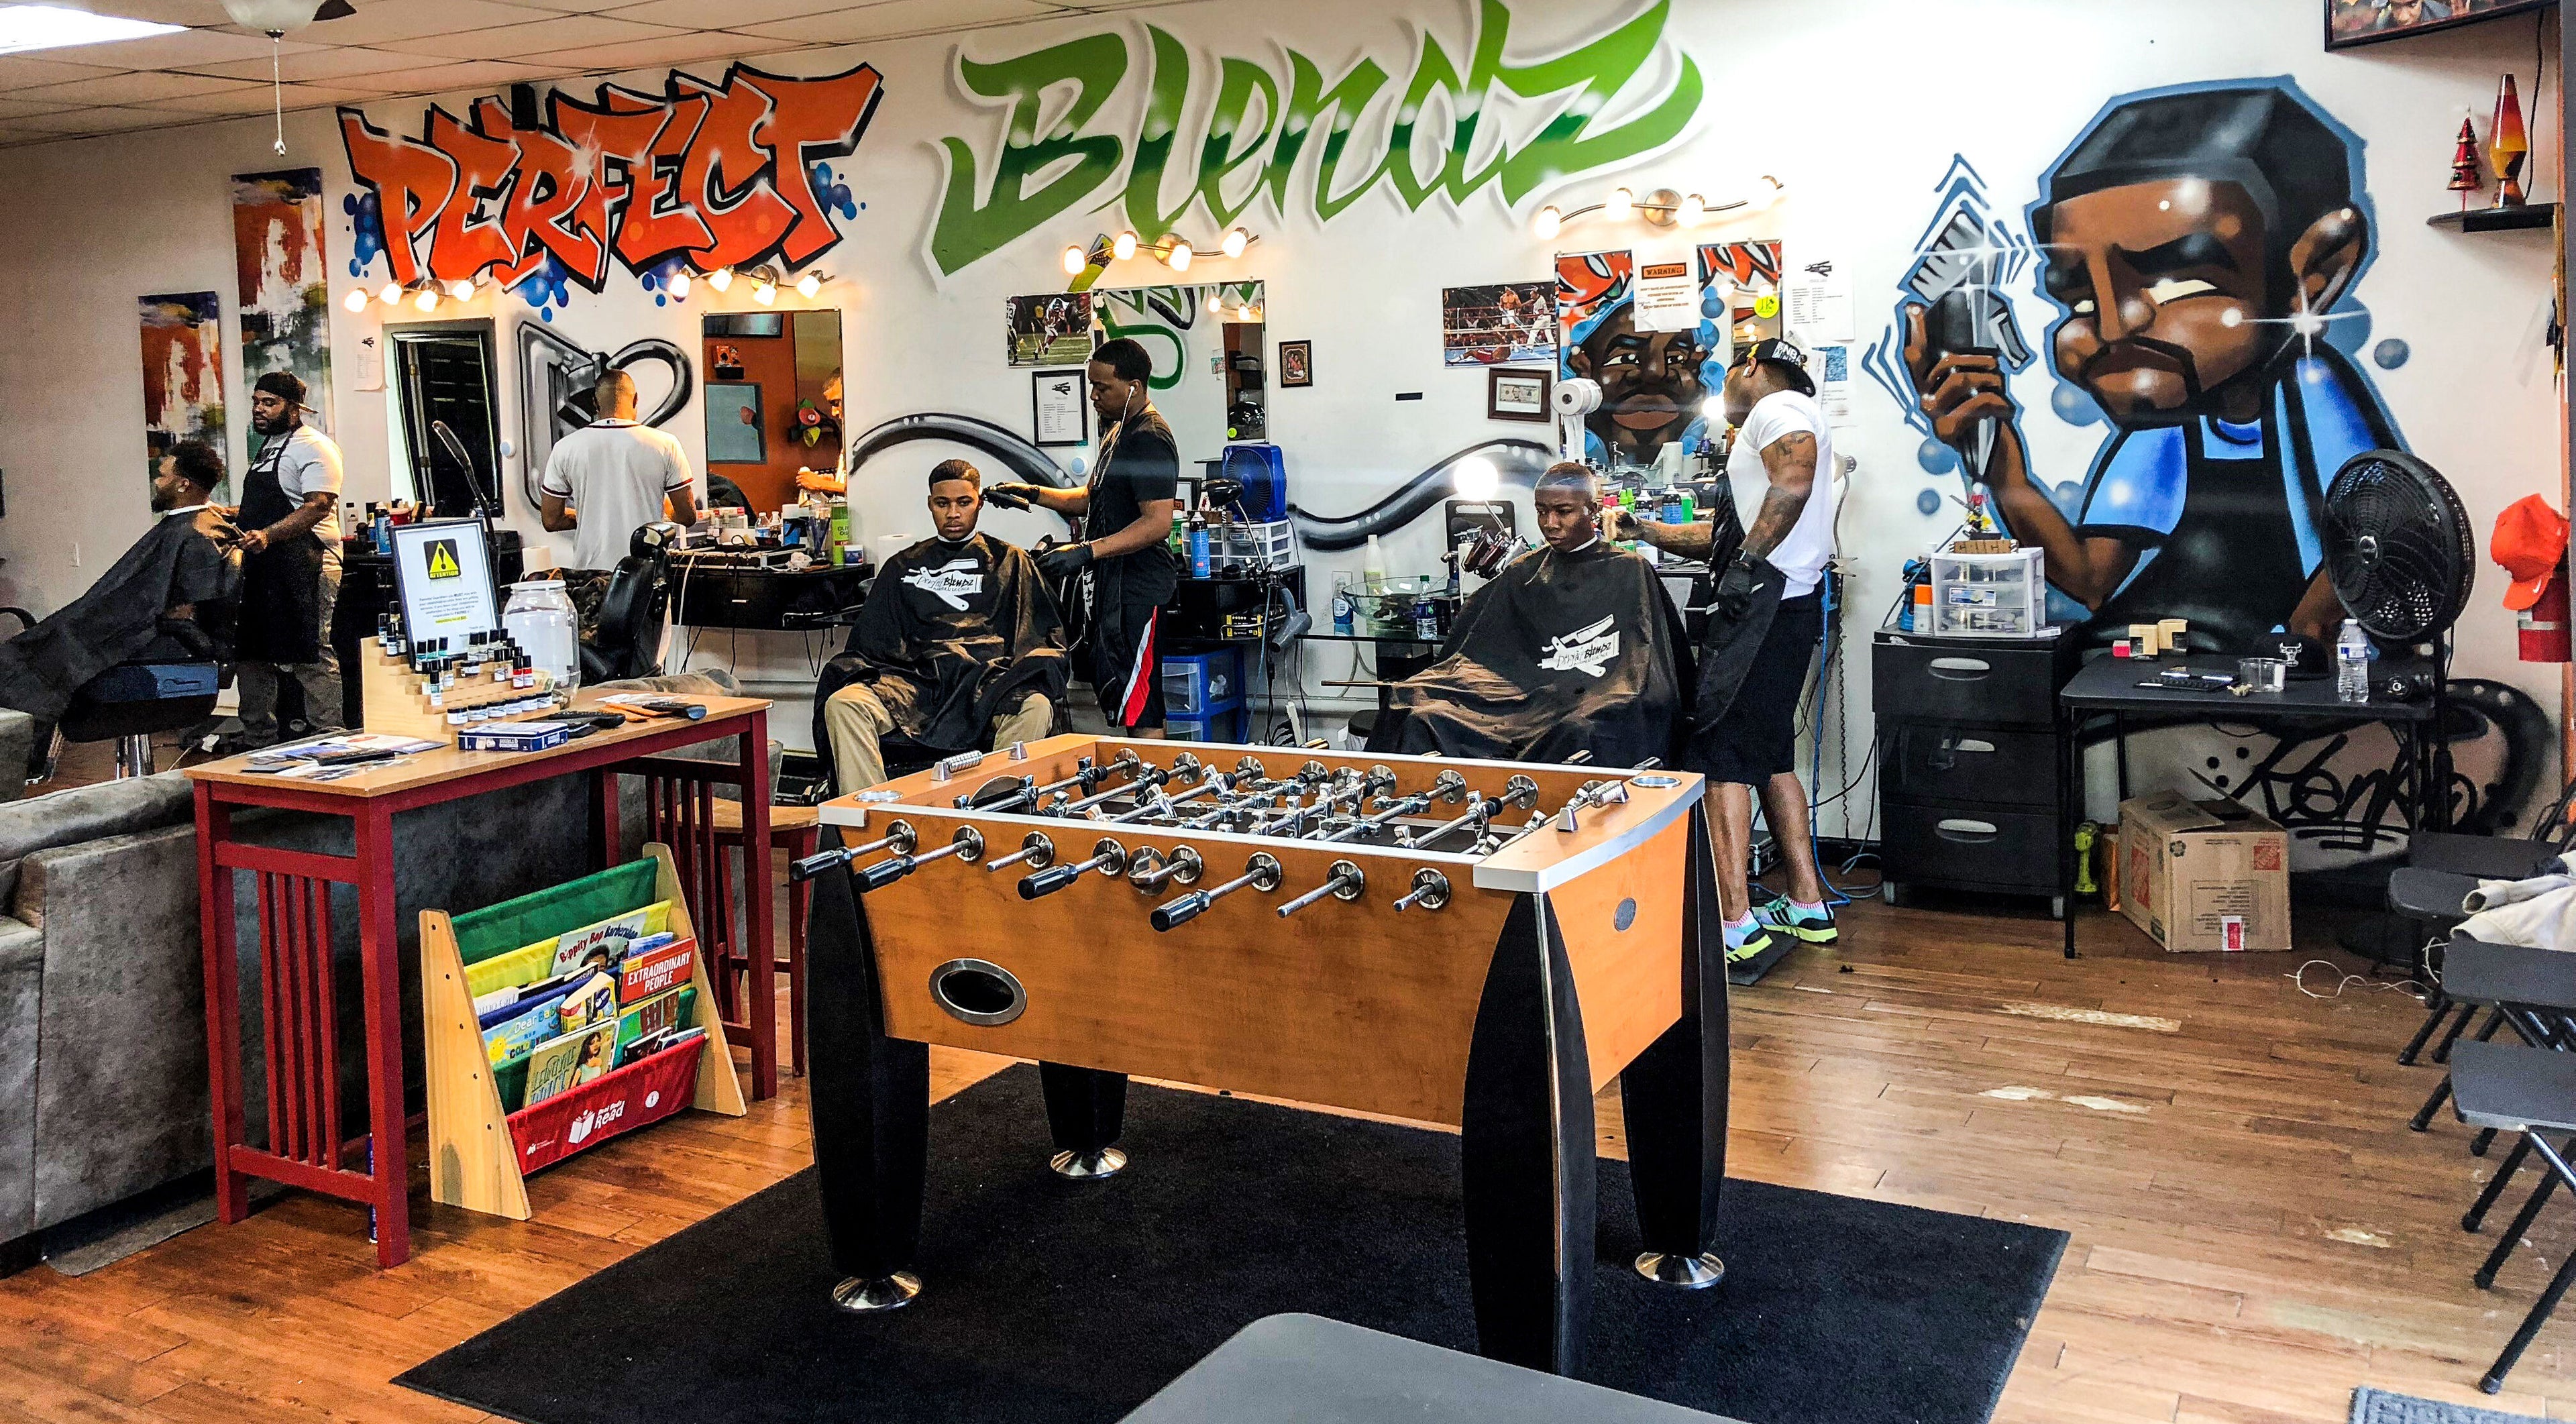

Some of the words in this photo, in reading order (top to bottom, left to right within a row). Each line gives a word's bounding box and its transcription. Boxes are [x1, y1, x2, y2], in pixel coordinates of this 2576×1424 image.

[337, 61, 883, 294] PERFECT
[1646, 266, 1683, 276] WARNING
[429, 570, 459, 579] ATTENTION
[559, 938, 588, 963] Bippity
[590, 930, 604, 944] Bop
[627, 950, 692, 986] EXTRAORDINARY
[644, 971, 674, 993] PEOPLE
[515, 1016, 537, 1034] Dear
[594, 1100, 625, 1130] Read
